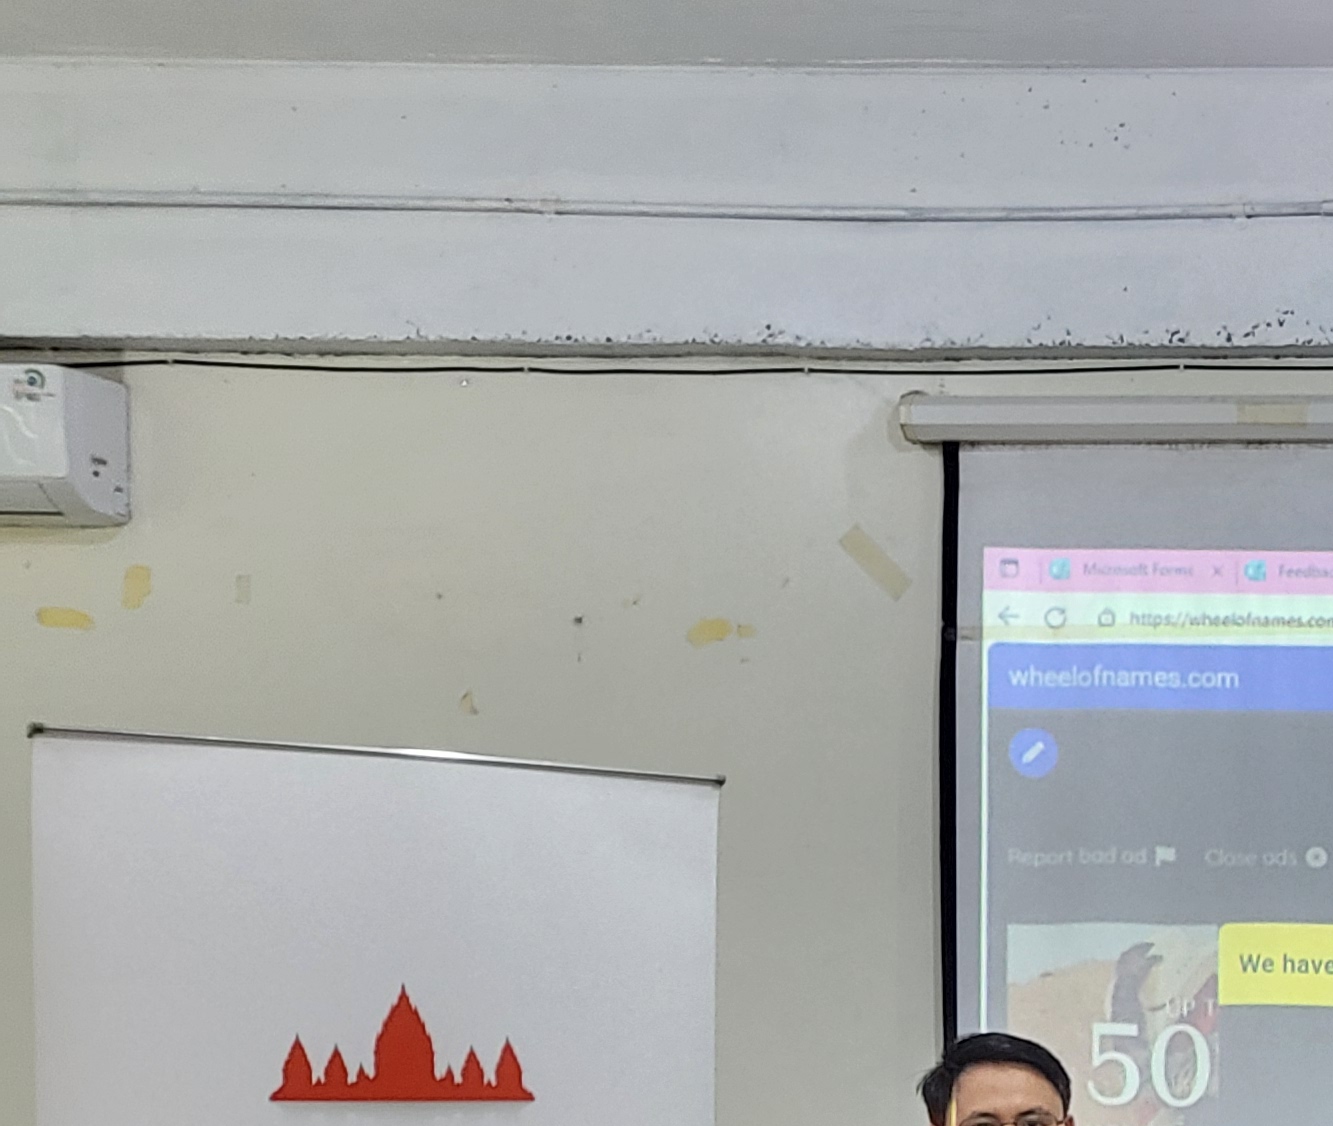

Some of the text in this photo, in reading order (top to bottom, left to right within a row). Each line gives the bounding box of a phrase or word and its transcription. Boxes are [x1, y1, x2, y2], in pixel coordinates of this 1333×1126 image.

[1008, 664, 1240, 689] wheelofnames.com
[1238, 953, 1276, 975] We
[1086, 1021, 1212, 1108] 50
